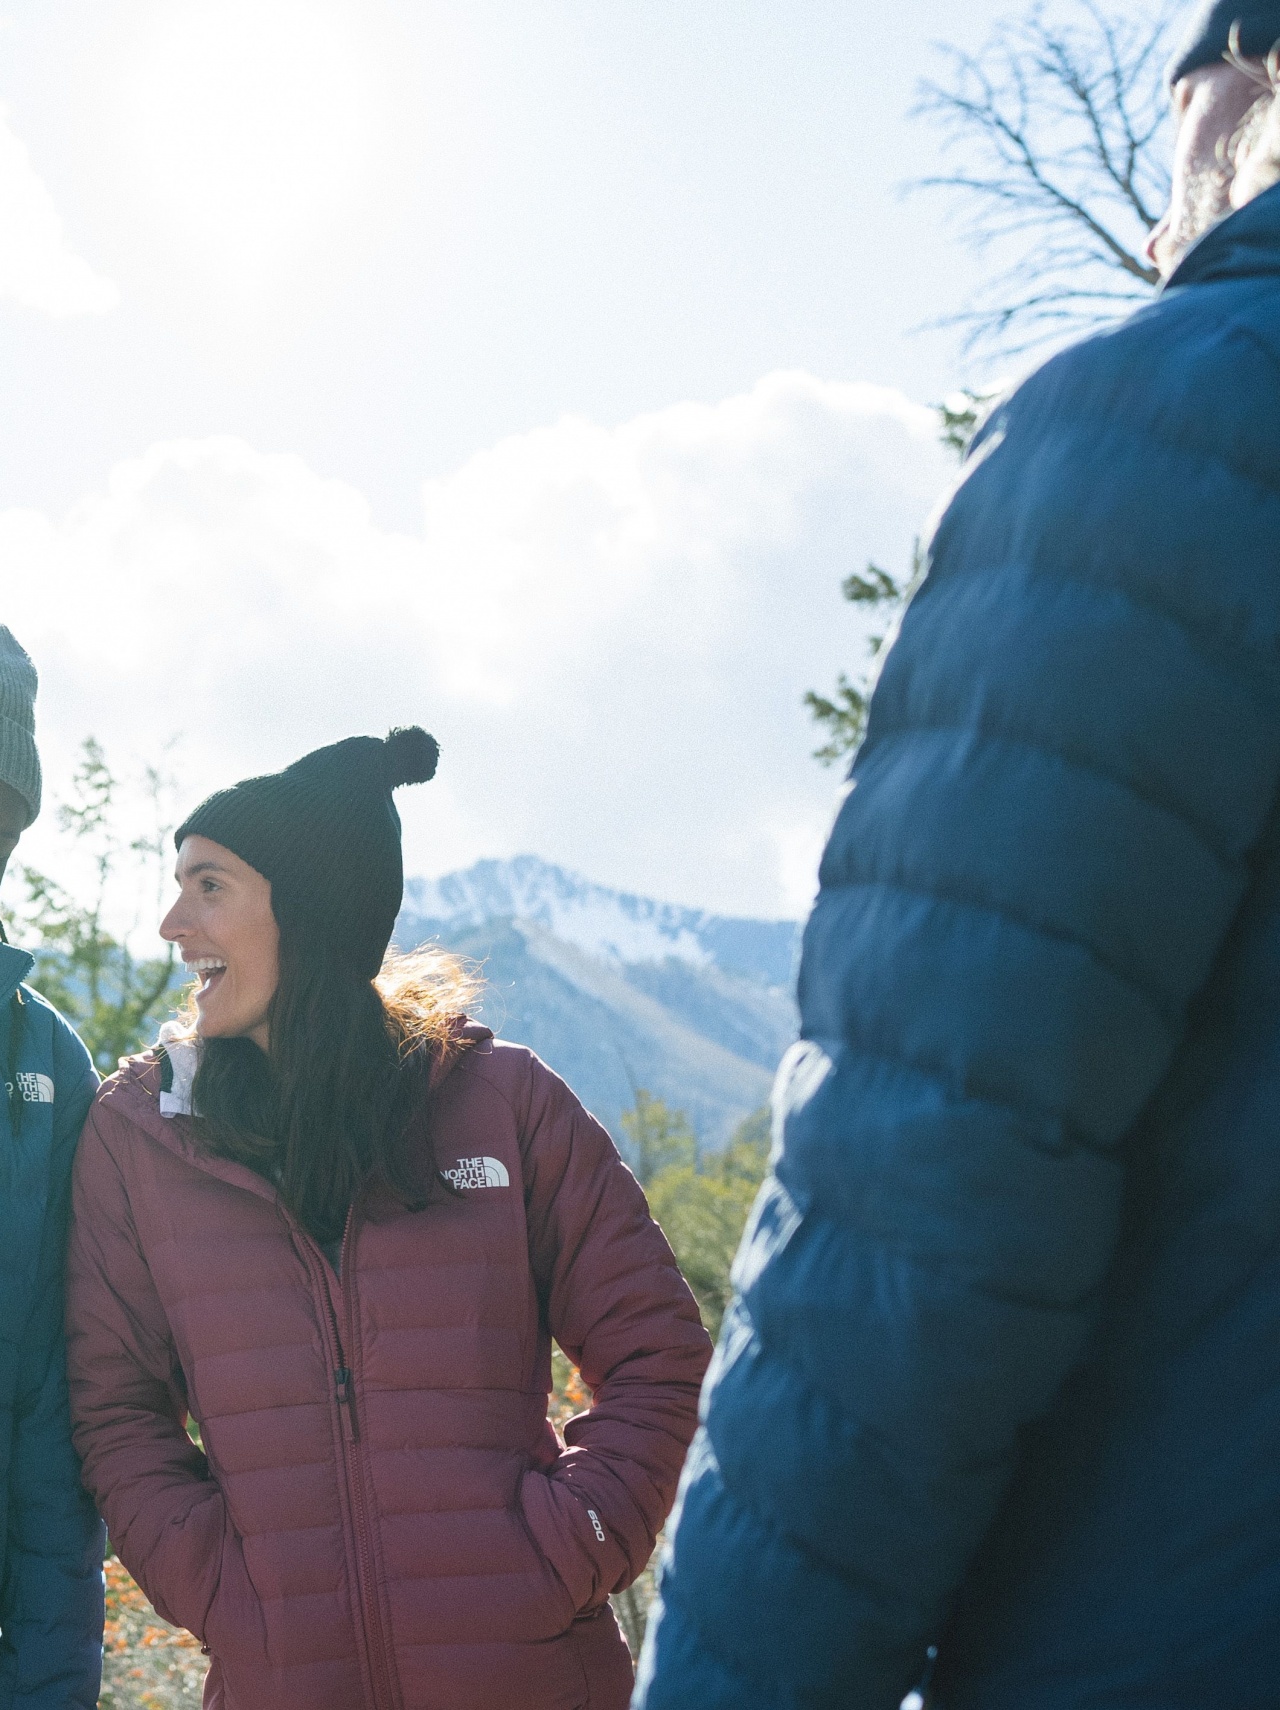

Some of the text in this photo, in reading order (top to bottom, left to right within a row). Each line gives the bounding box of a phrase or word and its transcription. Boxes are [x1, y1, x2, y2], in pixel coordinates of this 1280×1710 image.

[5, 1081, 38, 1092] OTH
[457, 1157, 483, 1168] THE
[453, 1177, 486, 1190] FACE
[587, 1509, 605, 1541] 600
